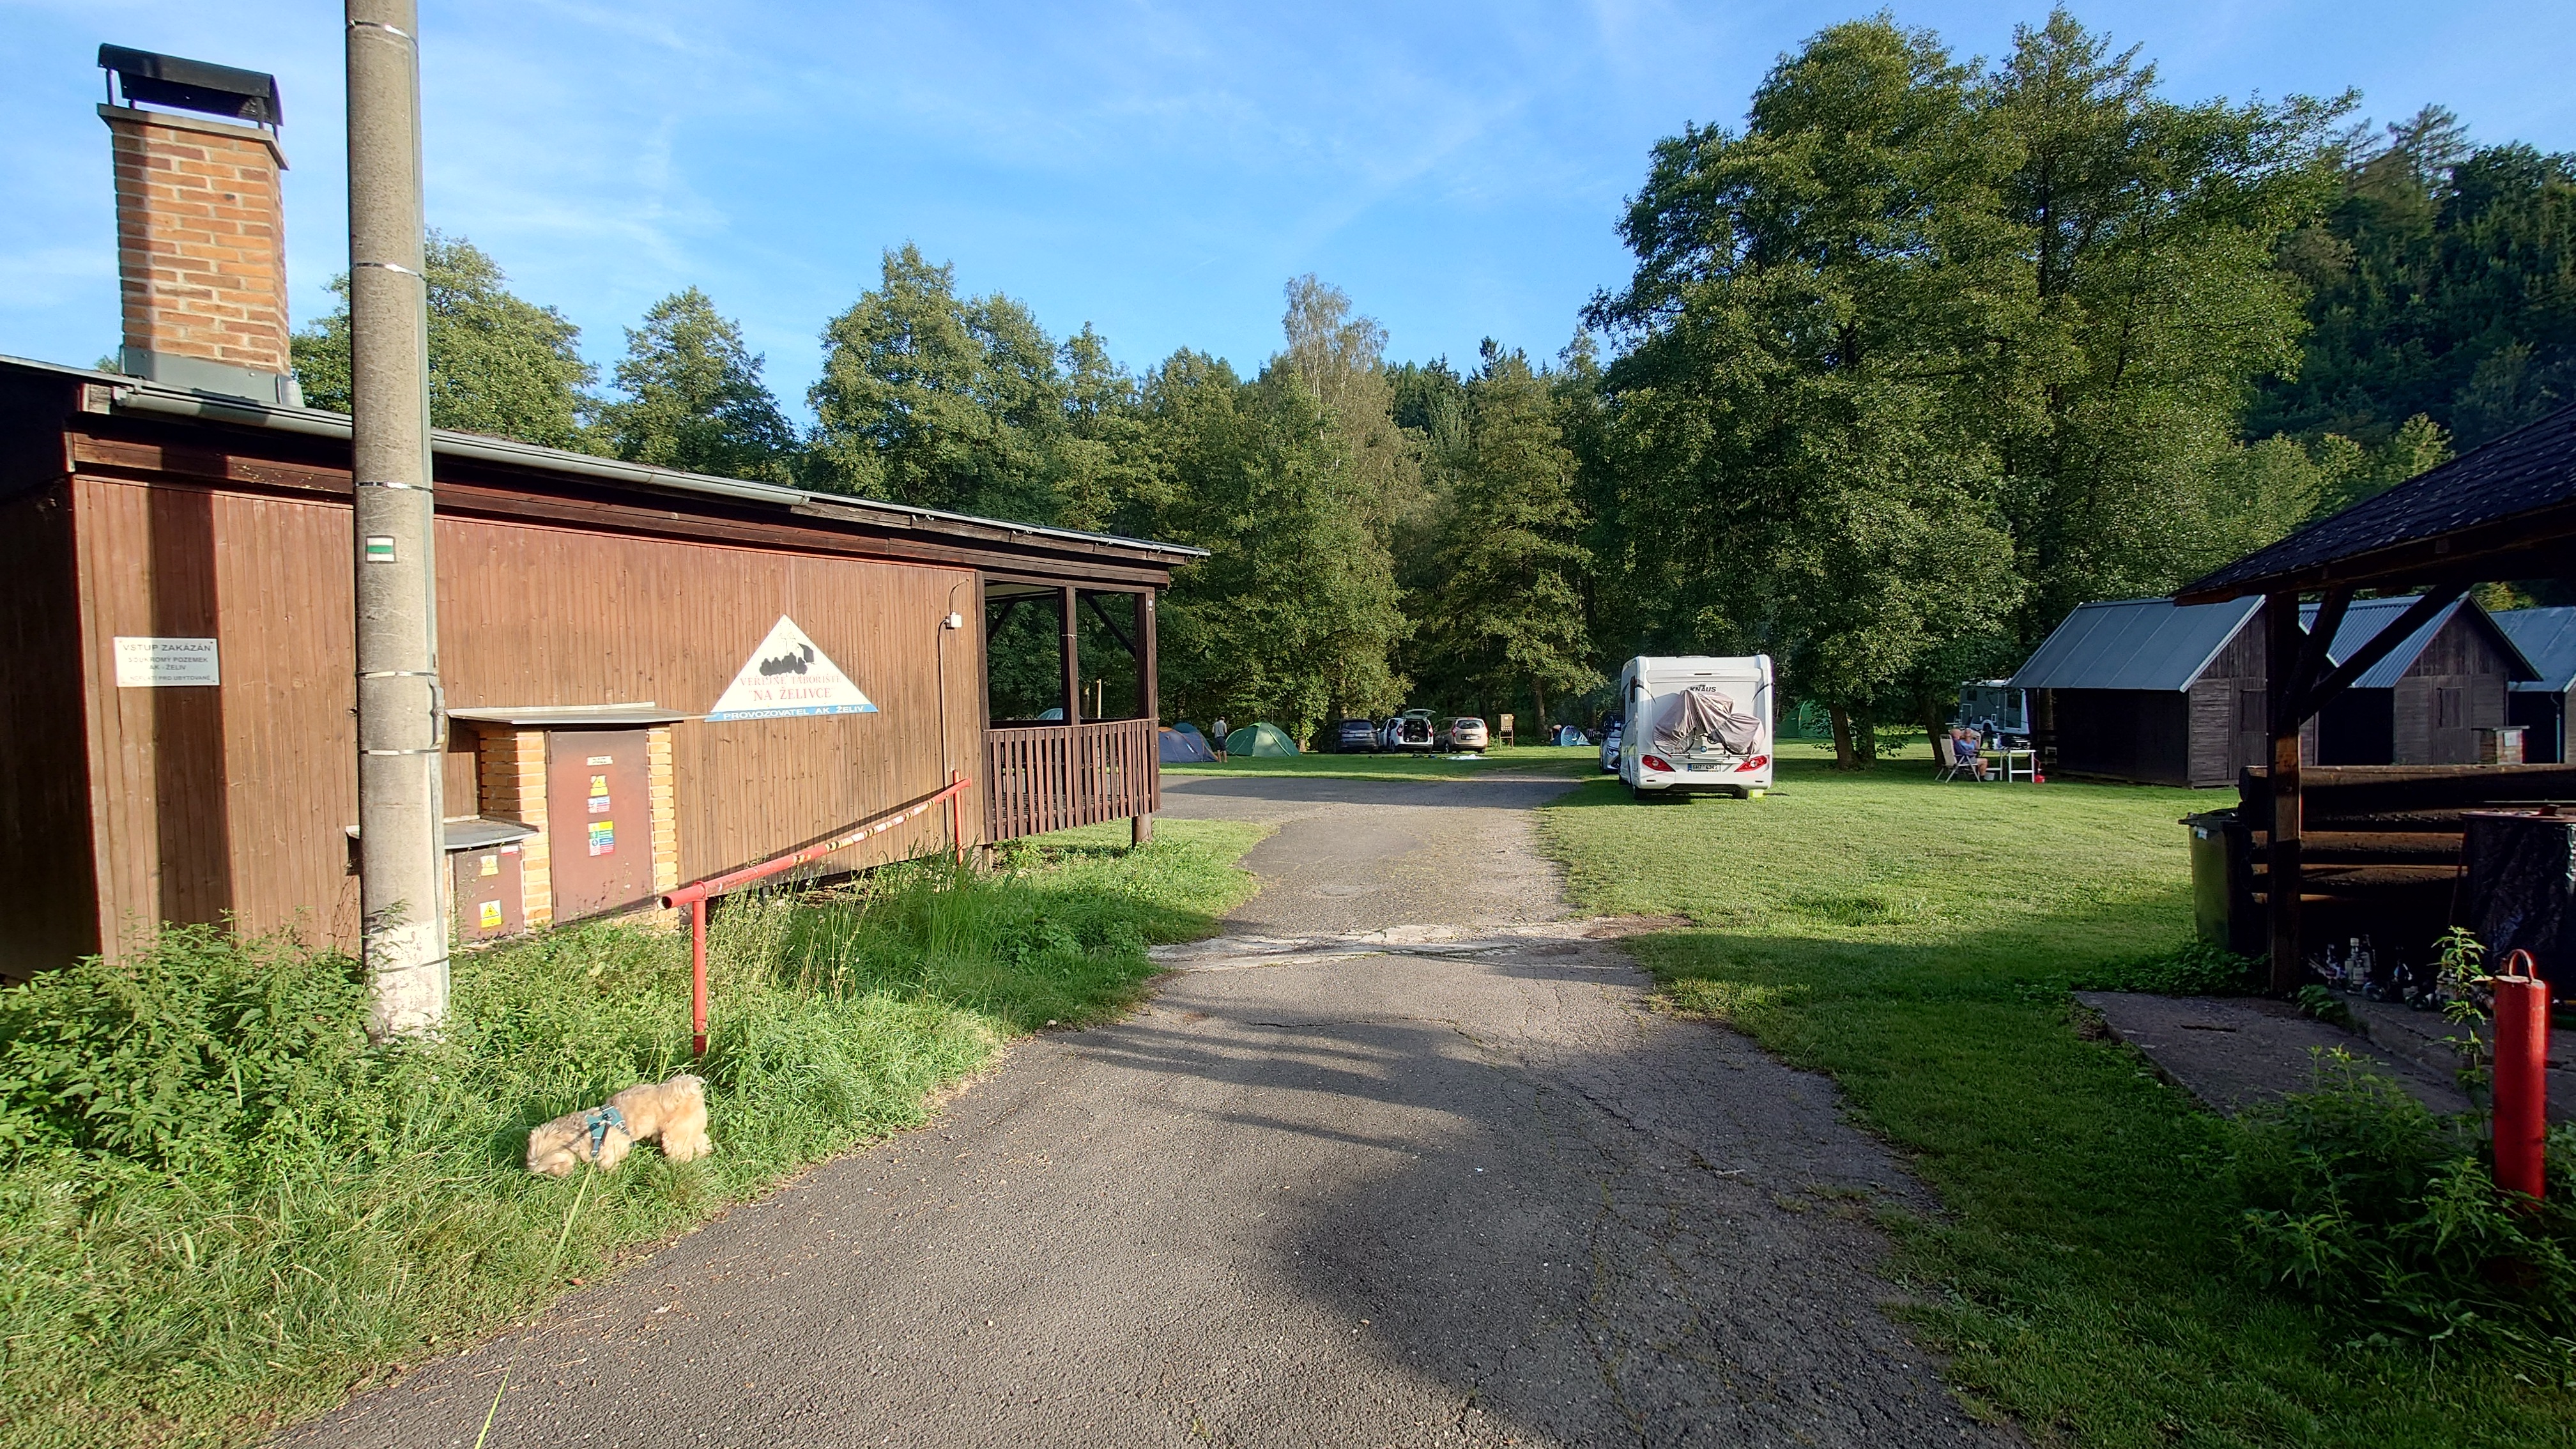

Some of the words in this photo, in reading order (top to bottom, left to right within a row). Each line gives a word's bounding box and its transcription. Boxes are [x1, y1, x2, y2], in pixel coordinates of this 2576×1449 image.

[162, 643, 211, 651] ZAKÁZÁN
[723, 707, 809, 720] PROVOZOVATEL
[836, 705, 864, 713] ŽELIV
